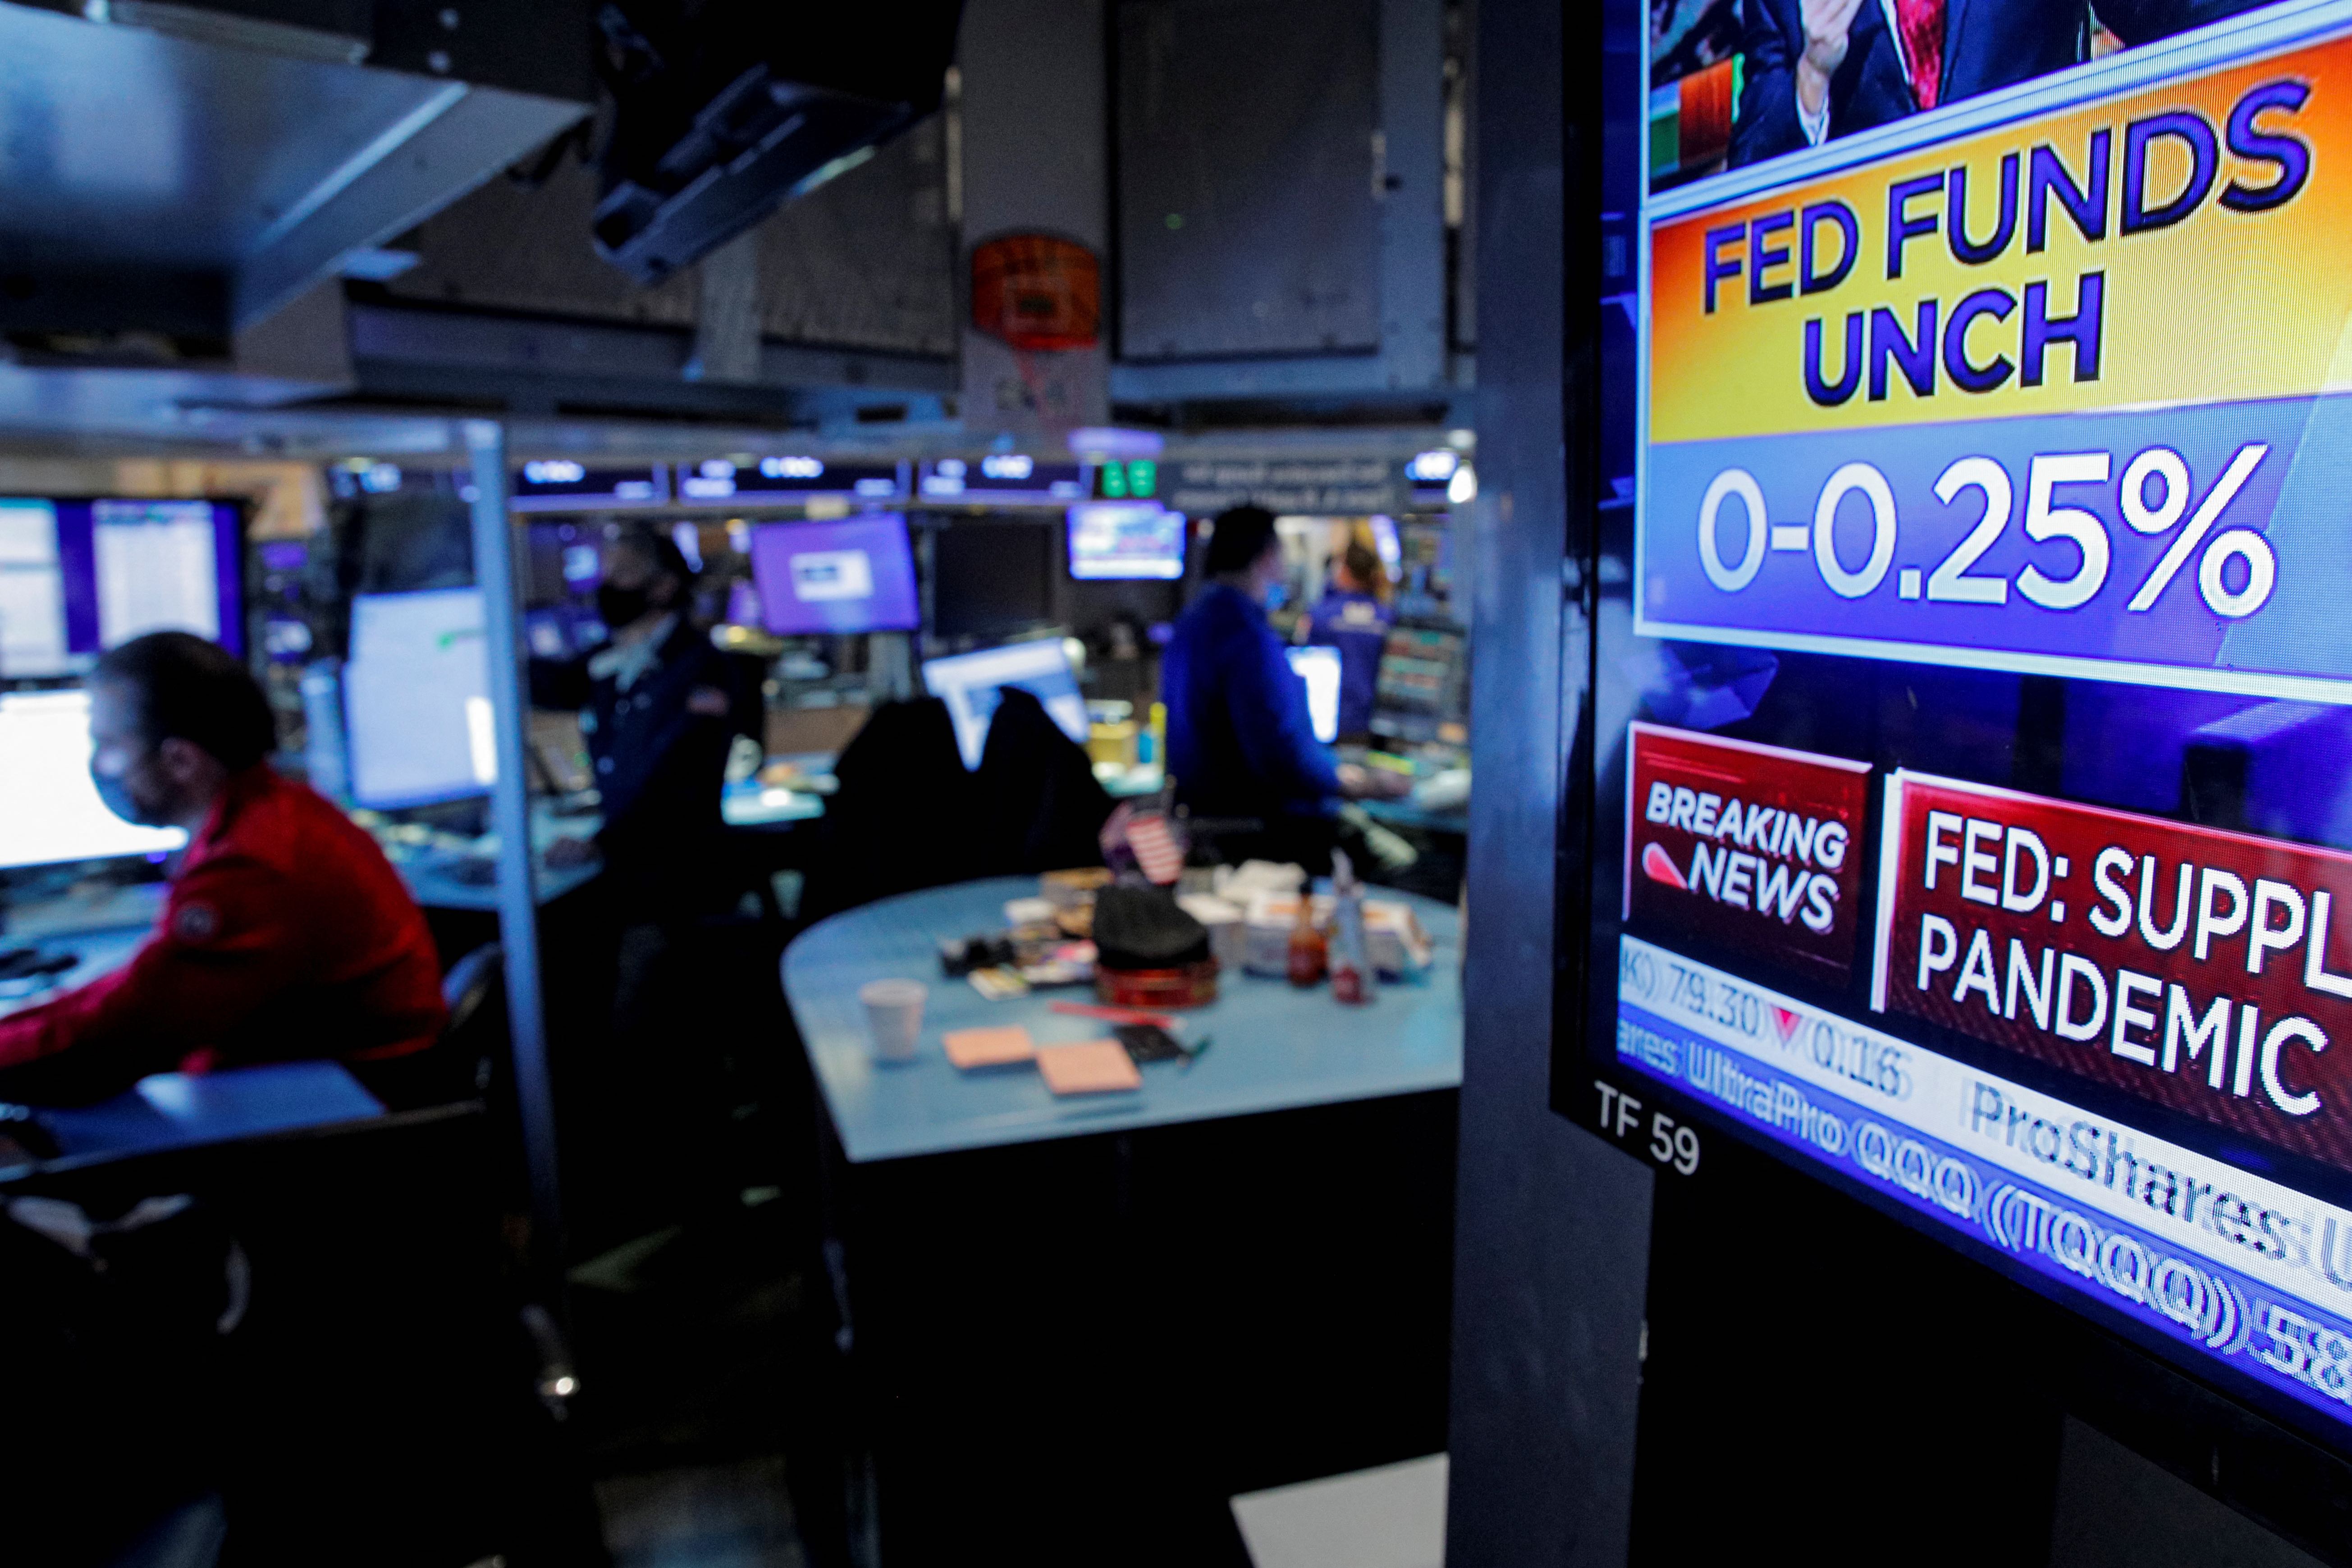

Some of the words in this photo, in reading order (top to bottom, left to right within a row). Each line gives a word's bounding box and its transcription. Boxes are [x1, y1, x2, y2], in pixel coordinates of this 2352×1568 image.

[1703, 199, 1860, 315] FED
[1886, 79, 2312, 281] FUNDS
[1803, 271, 2105, 407] UNCH
[1698, 443, 2276, 619] 0-0.25%
[1645, 781, 1849, 871] BREAKING
[1688, 841, 1839, 933] NEWS
[1924, 811, 2069, 922] FED:
[2088, 847, 2352, 998] SUPPL
[1917, 914, 2329, 1116] PANDEMIC
[1595, 1081, 1642, 1138] TF
[1650, 1113, 1700, 1175] 59
[1669, 963, 1761, 1038] 79.30
[1969, 1080, 2290, 1261] ProShares
[1851, 1119, 1982, 1223] QQQ
